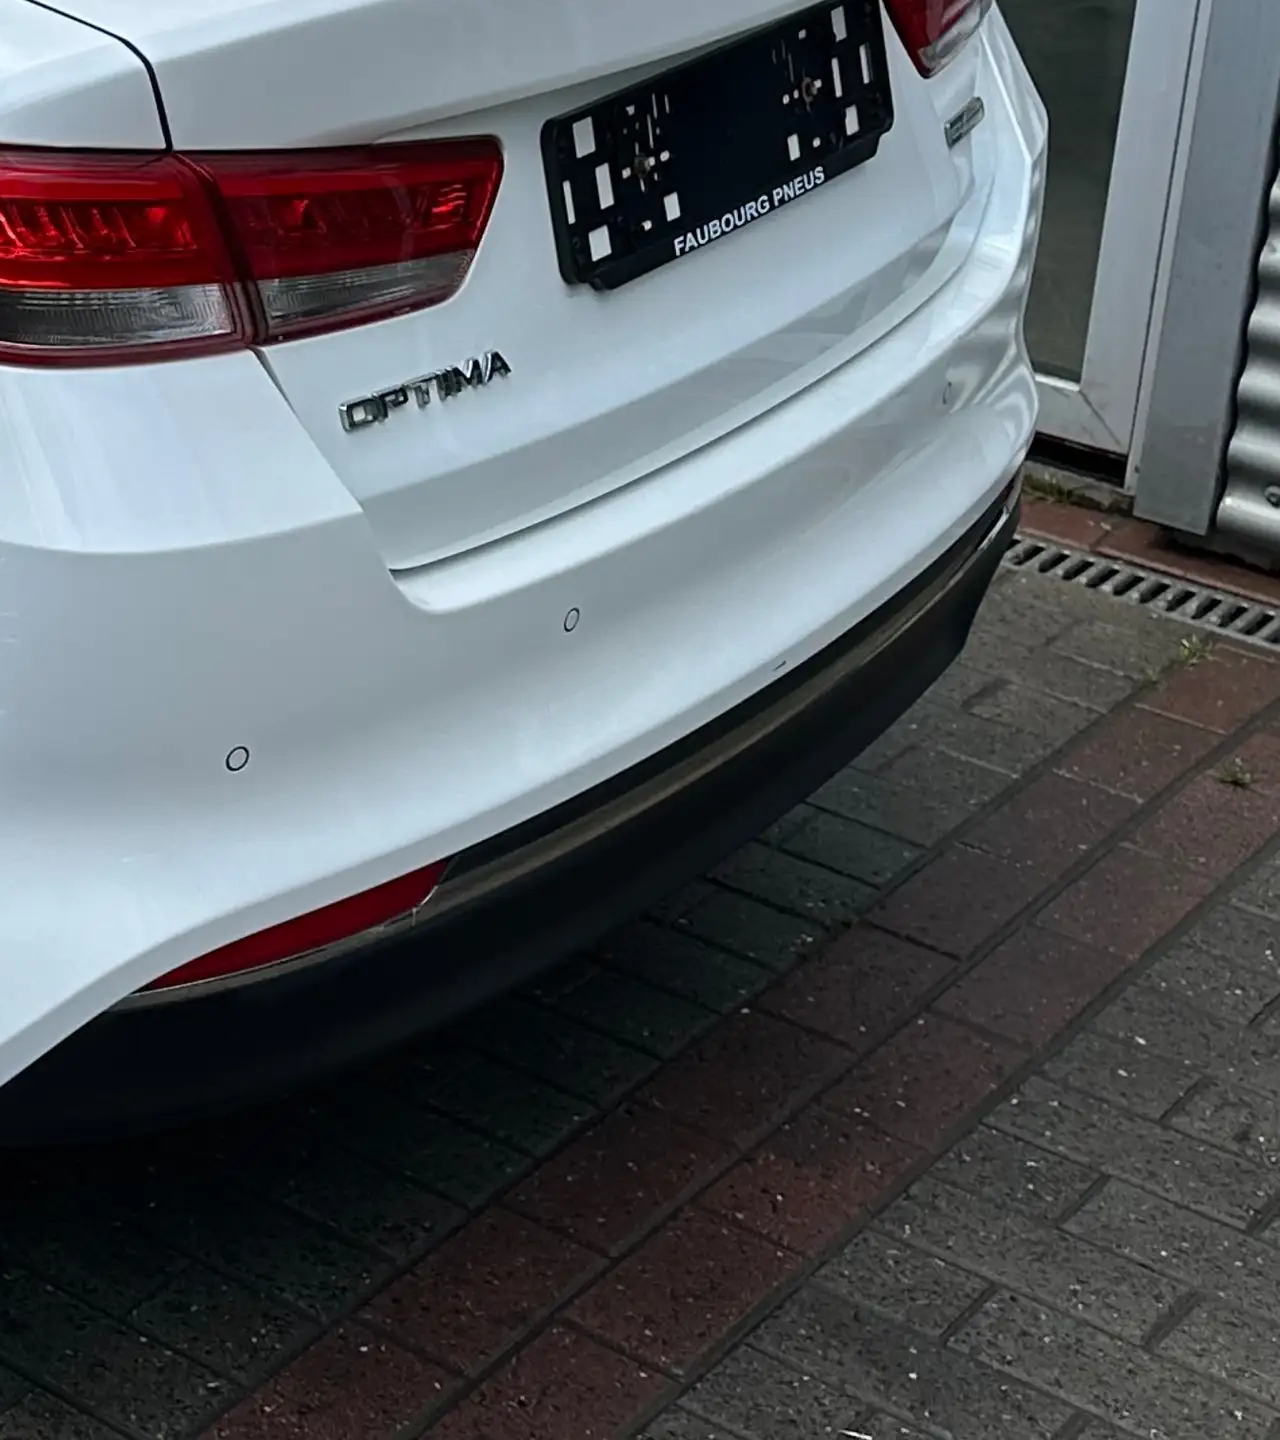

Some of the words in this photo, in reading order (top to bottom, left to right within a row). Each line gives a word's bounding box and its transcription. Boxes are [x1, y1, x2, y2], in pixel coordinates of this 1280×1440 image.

[673, 194, 770, 257] FAUBOURG
[772, 165, 826, 207] PNEUS
[338, 349, 513, 435] OPTIMA
